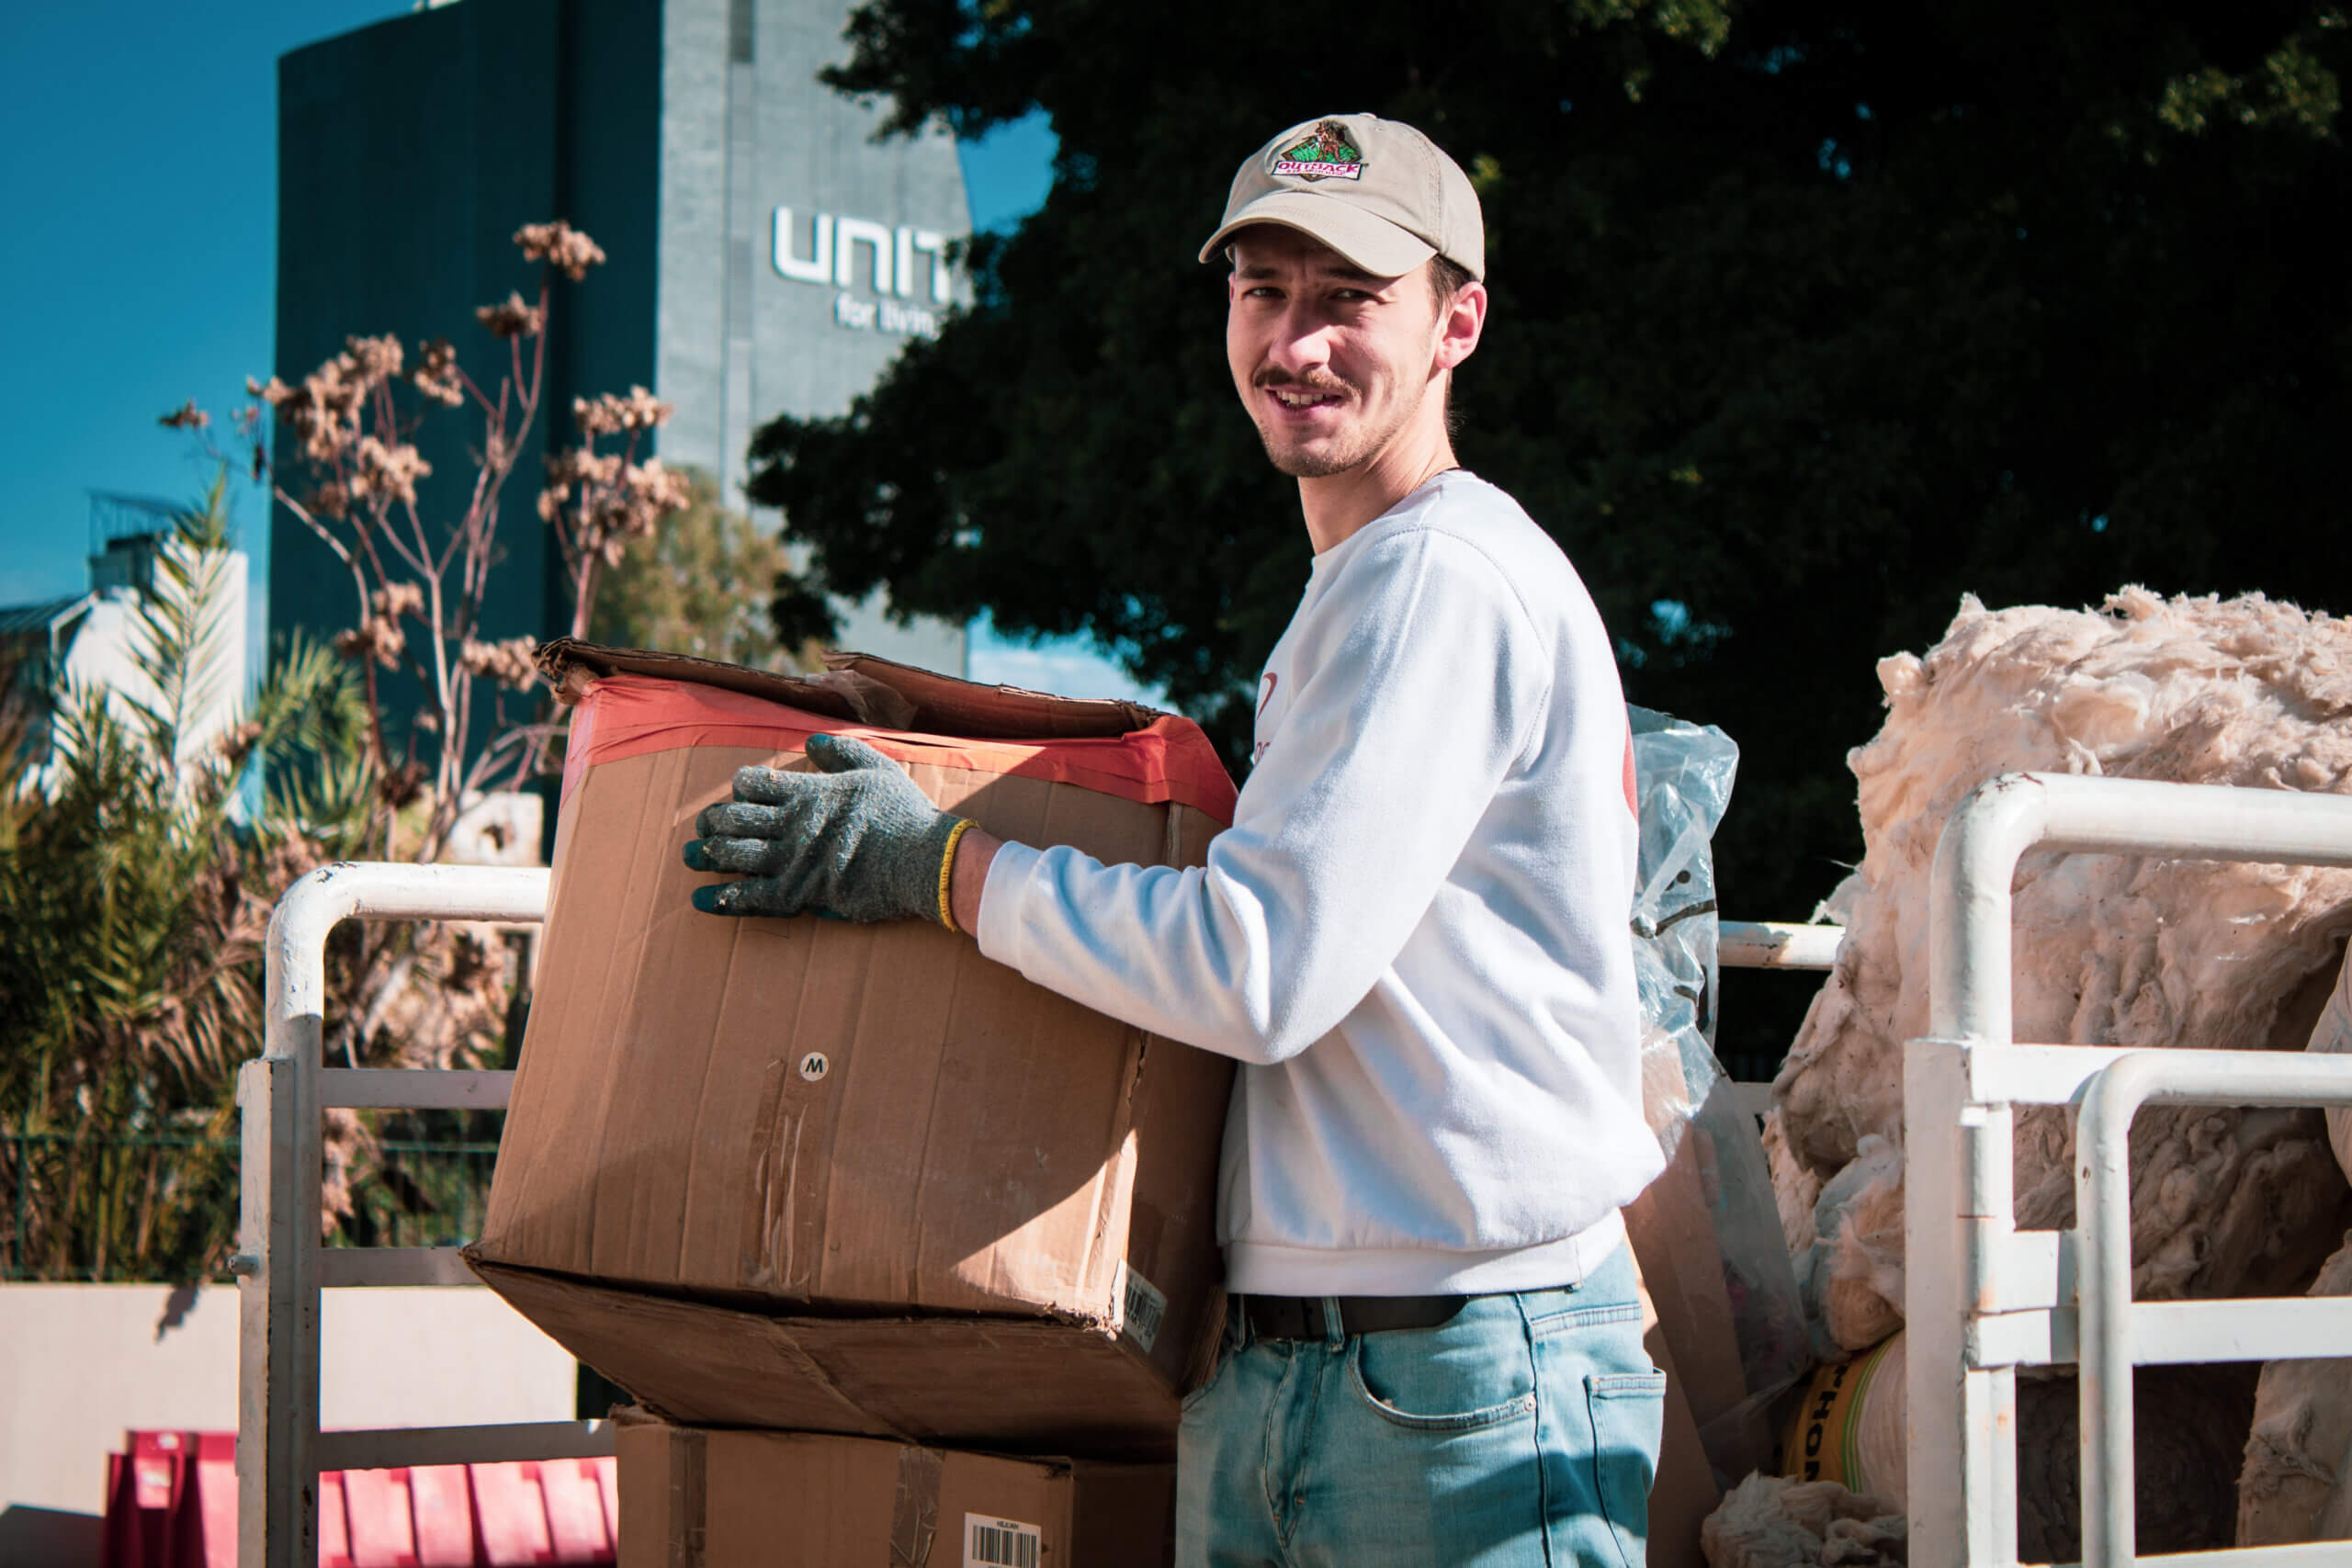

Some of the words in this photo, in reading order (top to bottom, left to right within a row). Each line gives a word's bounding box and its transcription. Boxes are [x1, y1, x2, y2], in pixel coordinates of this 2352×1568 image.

[1278, 161, 1359, 173] OUTBACK
[835, 291, 875, 328] for
[805, 1057, 824, 1073] M
